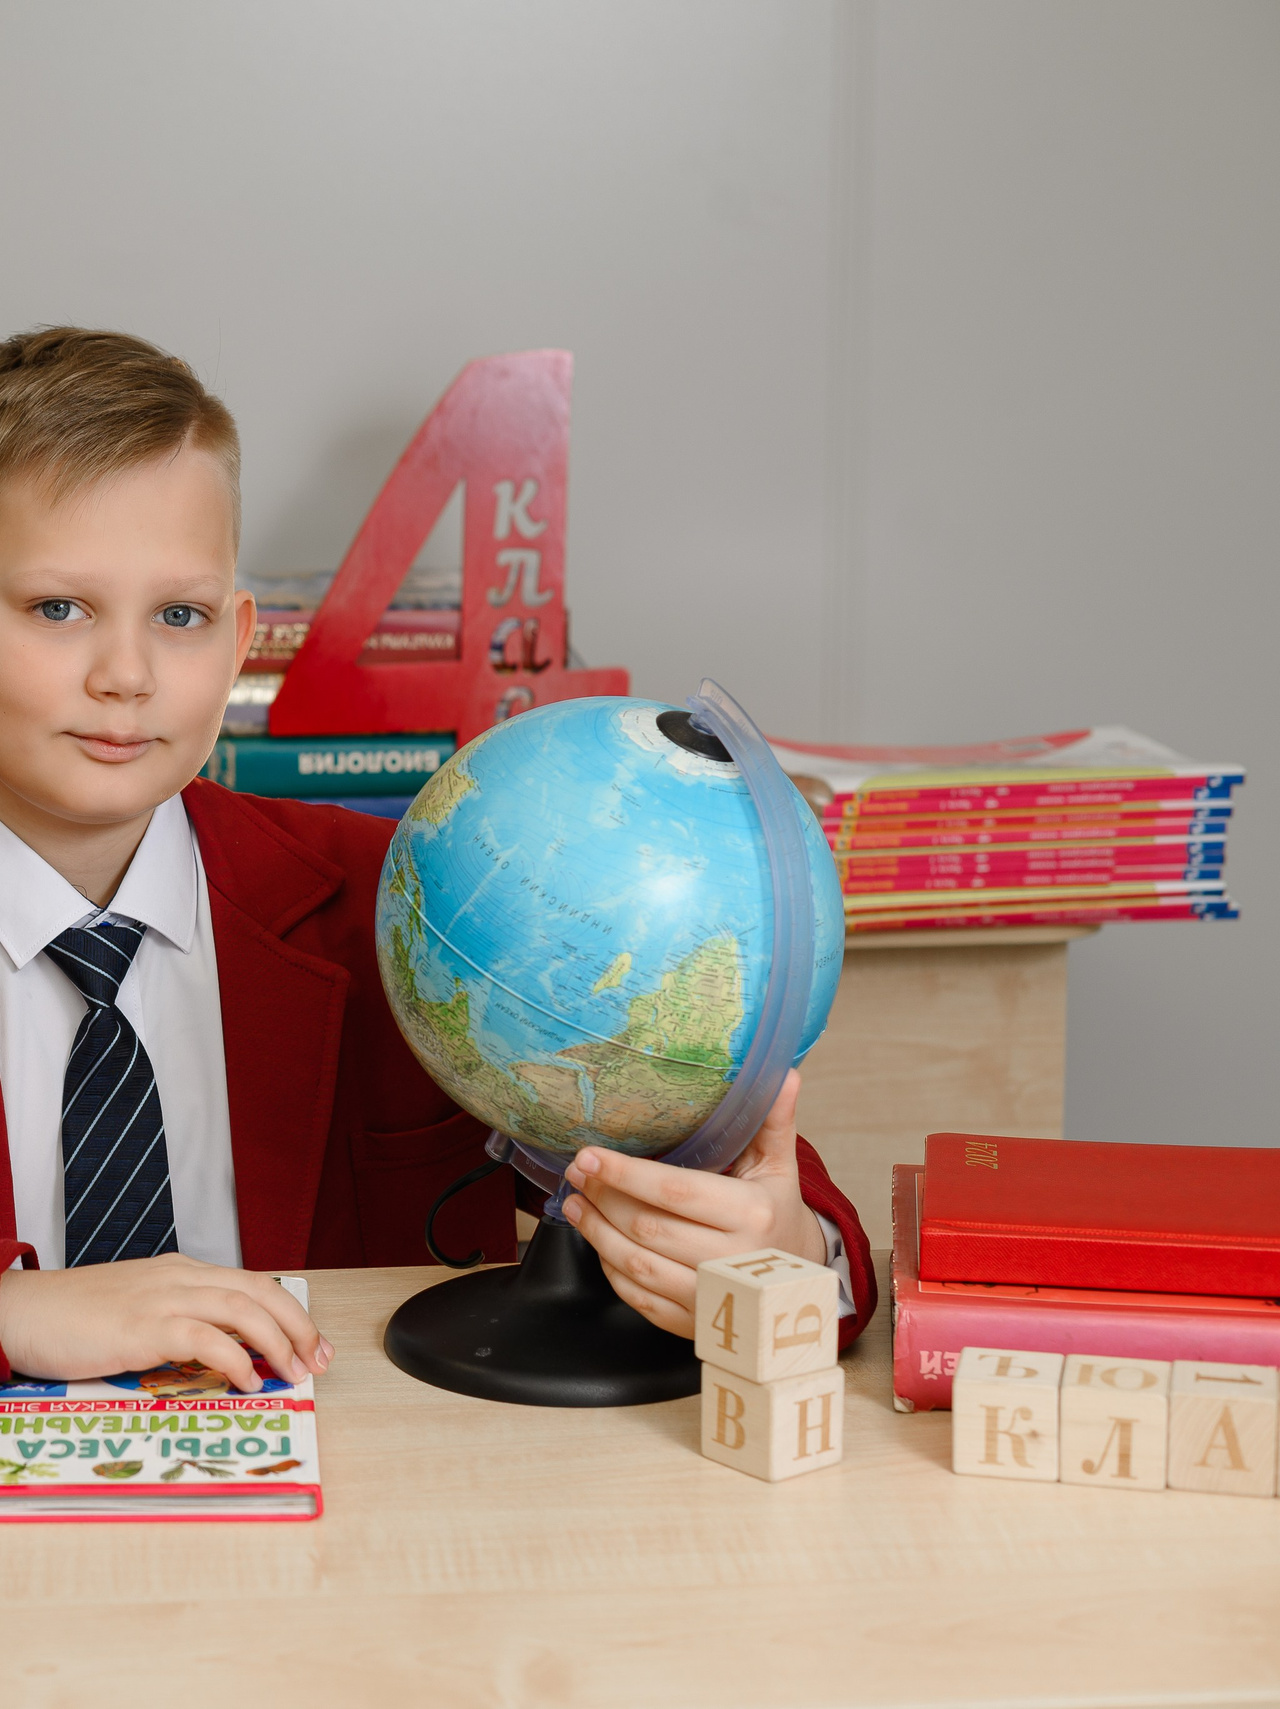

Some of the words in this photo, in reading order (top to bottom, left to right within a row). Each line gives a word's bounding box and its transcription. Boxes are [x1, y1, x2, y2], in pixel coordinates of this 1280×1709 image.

[298, 750, 441, 776] БИОЛОГИЯ
[965, 1140, 998, 1170] 2024
[711, 1292, 739, 1355] 4
[1076, 1363, 1159, 1391] Ю
[49, 1399, 157, 1413] ДЕТСКАЯ
[165, 1399, 285, 1411] БОЛЬШАЯ
[711, 1382, 746, 1451] В
[793, 1391, 837, 1461] Н
[16, 1438, 132, 1459] ЛЕСА
